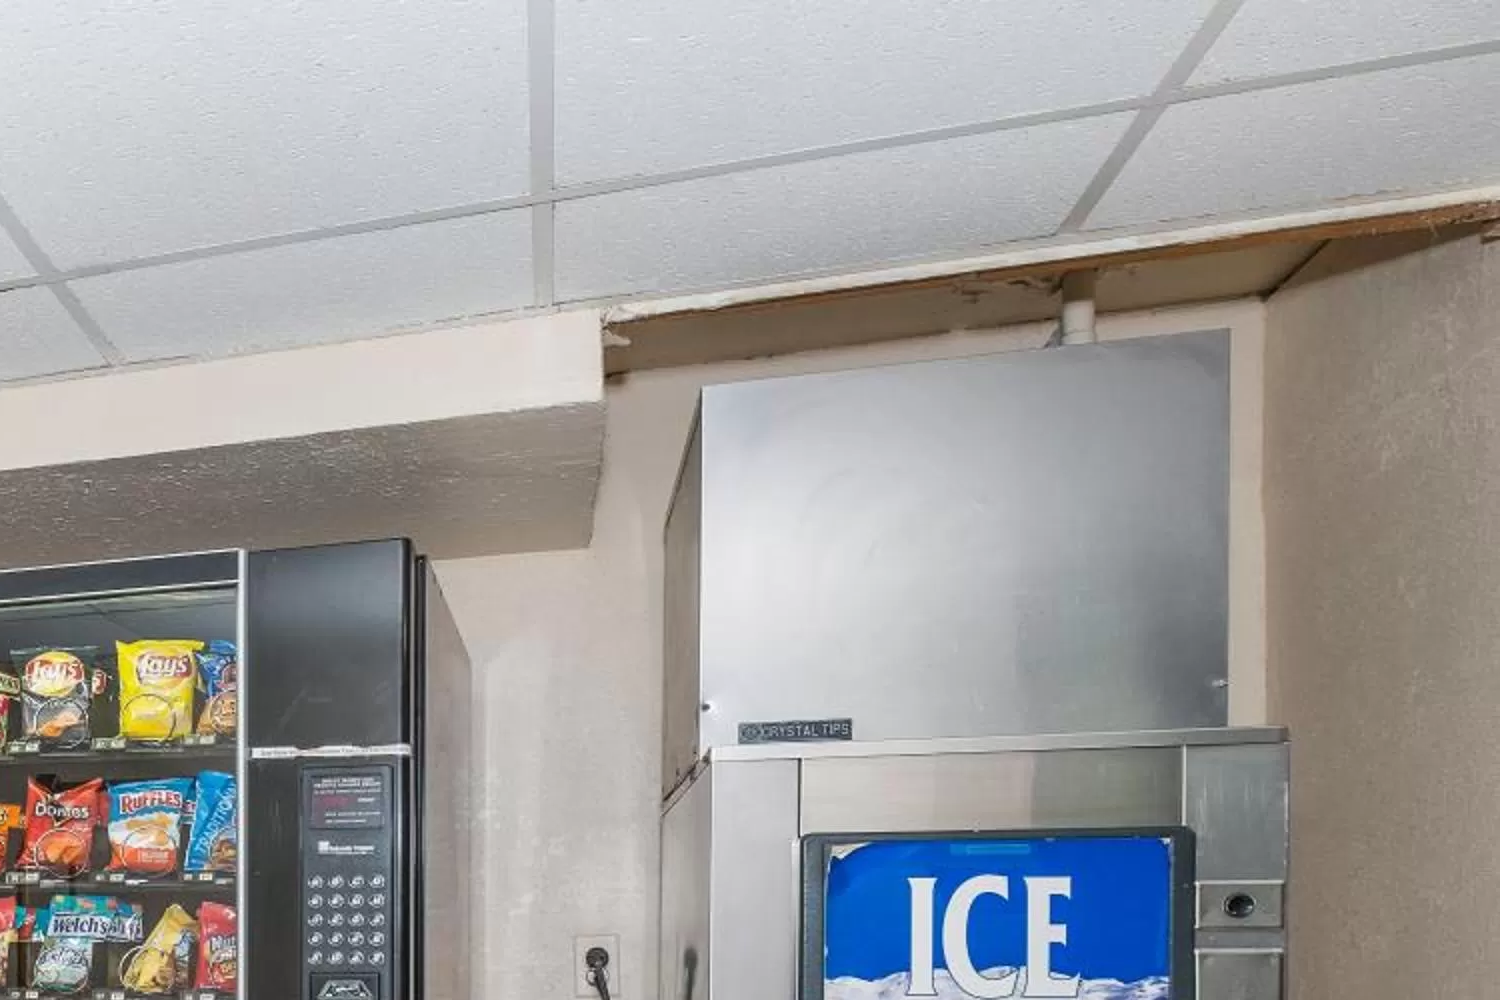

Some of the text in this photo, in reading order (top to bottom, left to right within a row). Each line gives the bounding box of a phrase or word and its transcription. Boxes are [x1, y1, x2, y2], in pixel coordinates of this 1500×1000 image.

[137, 653, 188, 679] Lay's
[821, 723, 850, 736] TIPS
[34, 801, 90, 819] Doritos
[119, 789, 184, 815] RUFFLES
[52, 916, 109, 935] Welch's
[905, 873, 1082, 1000] ICE
